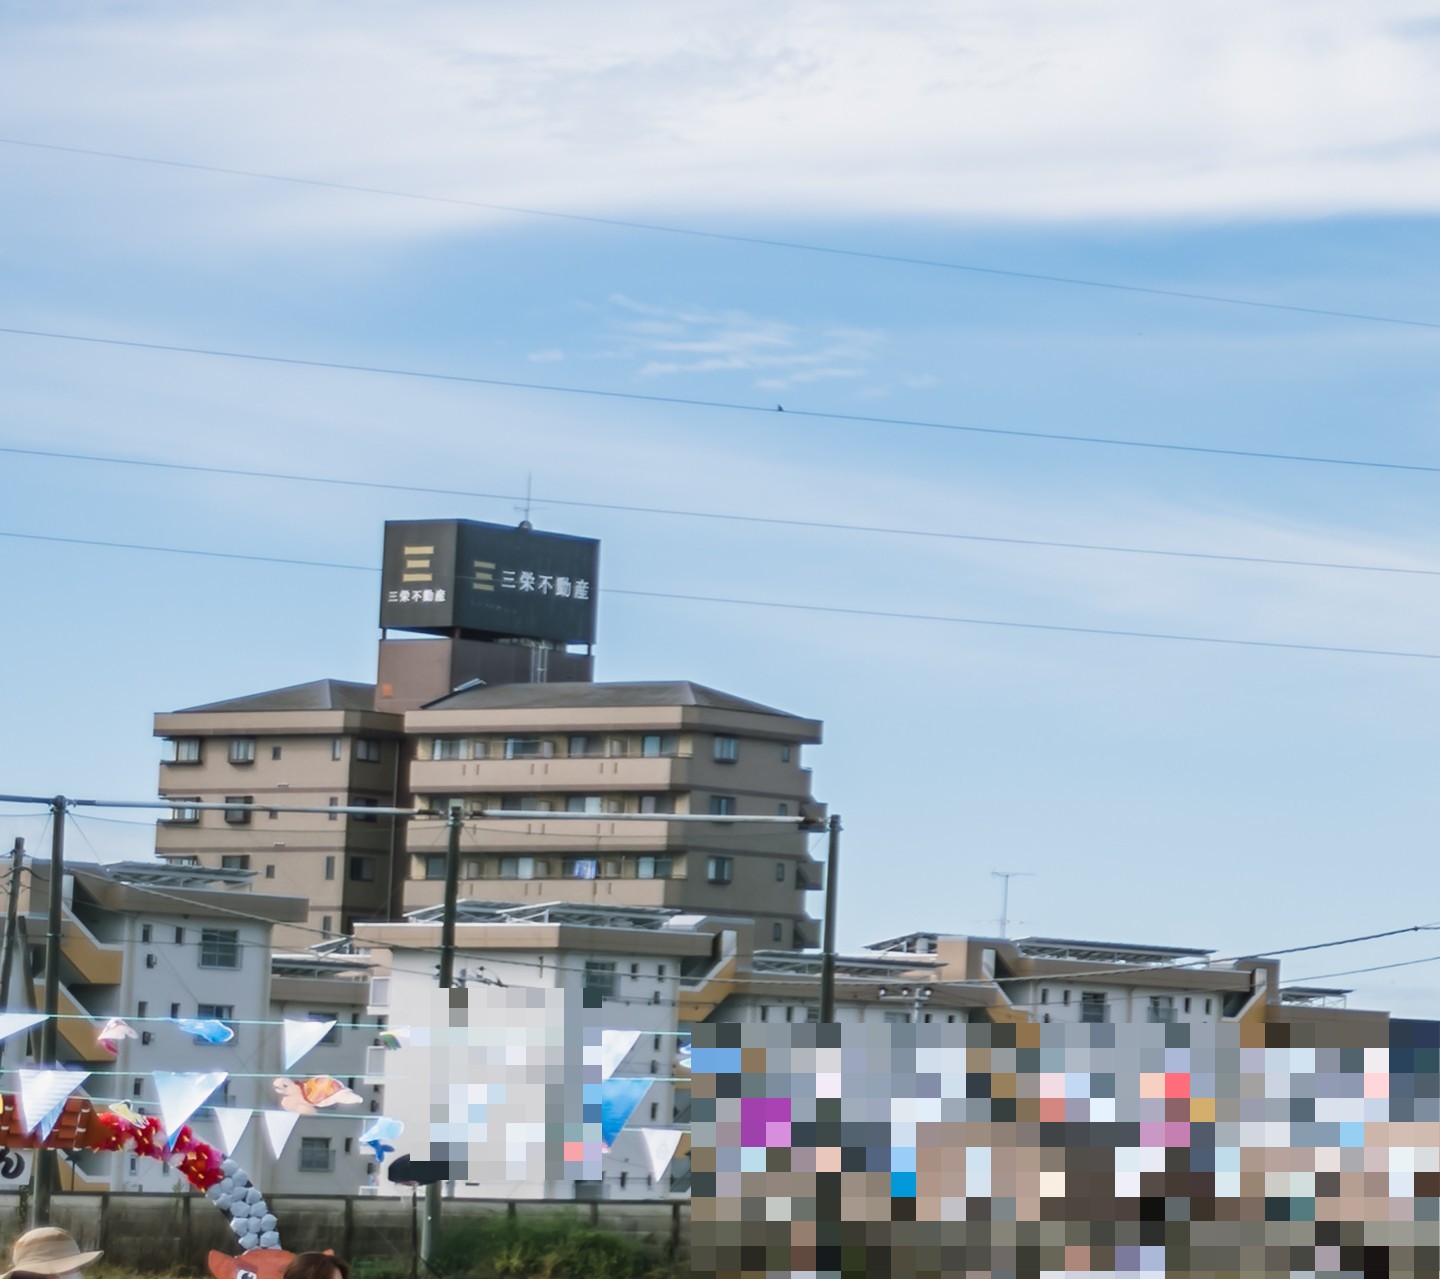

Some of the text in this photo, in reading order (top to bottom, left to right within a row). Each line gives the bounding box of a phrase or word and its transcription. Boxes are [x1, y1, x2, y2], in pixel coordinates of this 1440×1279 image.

[388, 588, 446, 603] 三栄不動産
[501, 570, 589, 600] 三栄不動産
